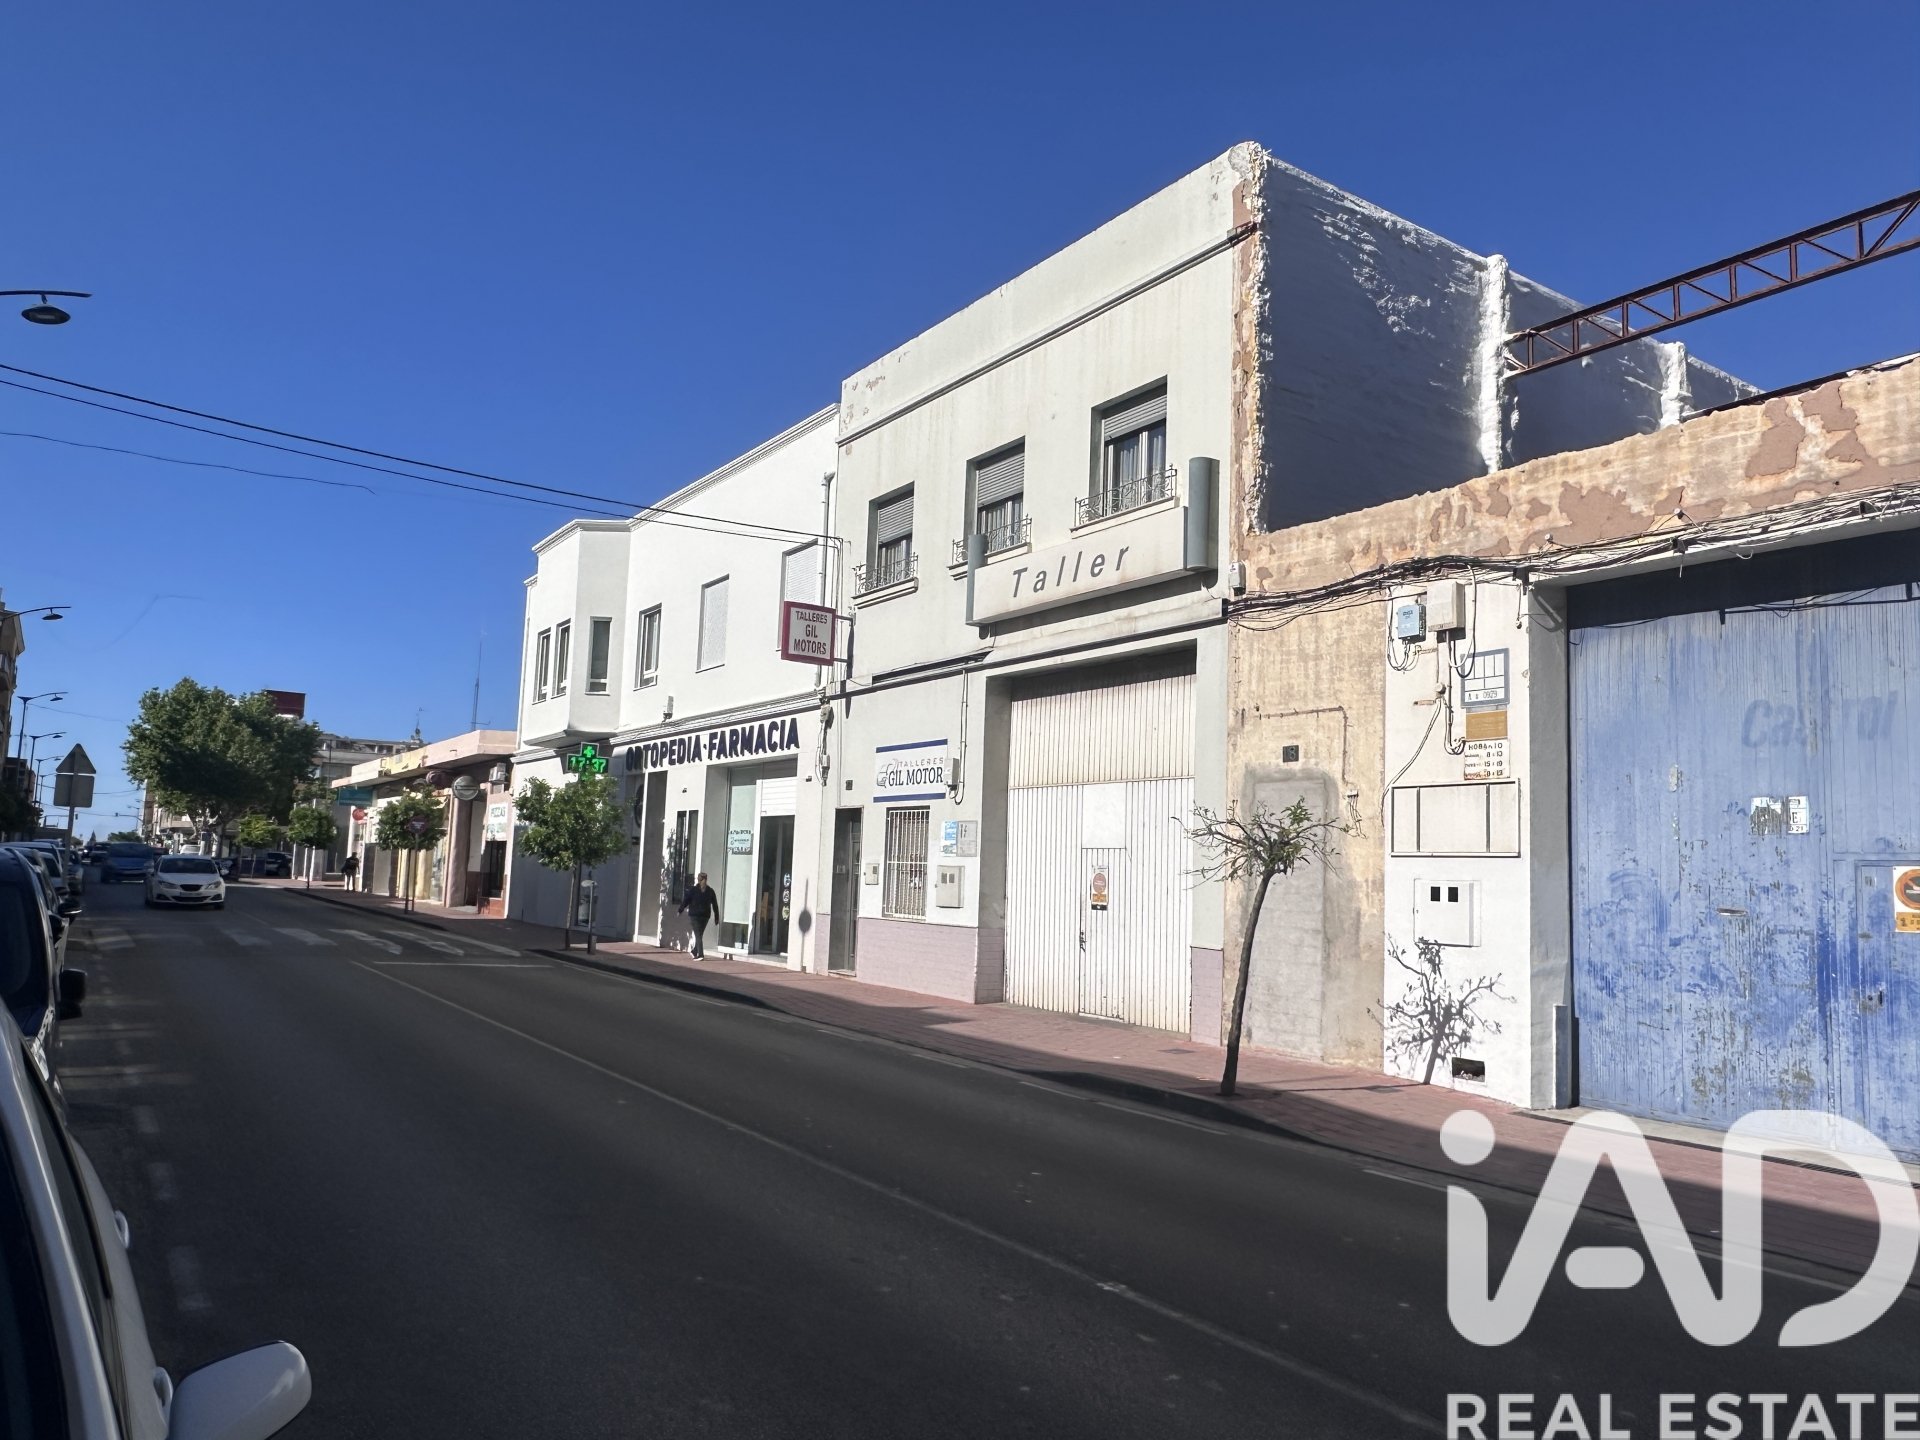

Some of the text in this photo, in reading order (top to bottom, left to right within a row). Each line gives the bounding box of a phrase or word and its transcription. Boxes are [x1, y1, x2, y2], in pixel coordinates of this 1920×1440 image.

[1012, 545, 1130, 598] Taller
[795, 610, 828, 625] TALLERES
[805, 624, 818, 639] GIL
[793, 638, 827, 655] MOTORS
[625, 717, 801, 771] ORTOPEDIA FARMACIA
[570, 756, 607, 773] 17:37
[898, 757, 944, 768] TALLERES
[888, 766, 943, 787] GIL MOTOR
